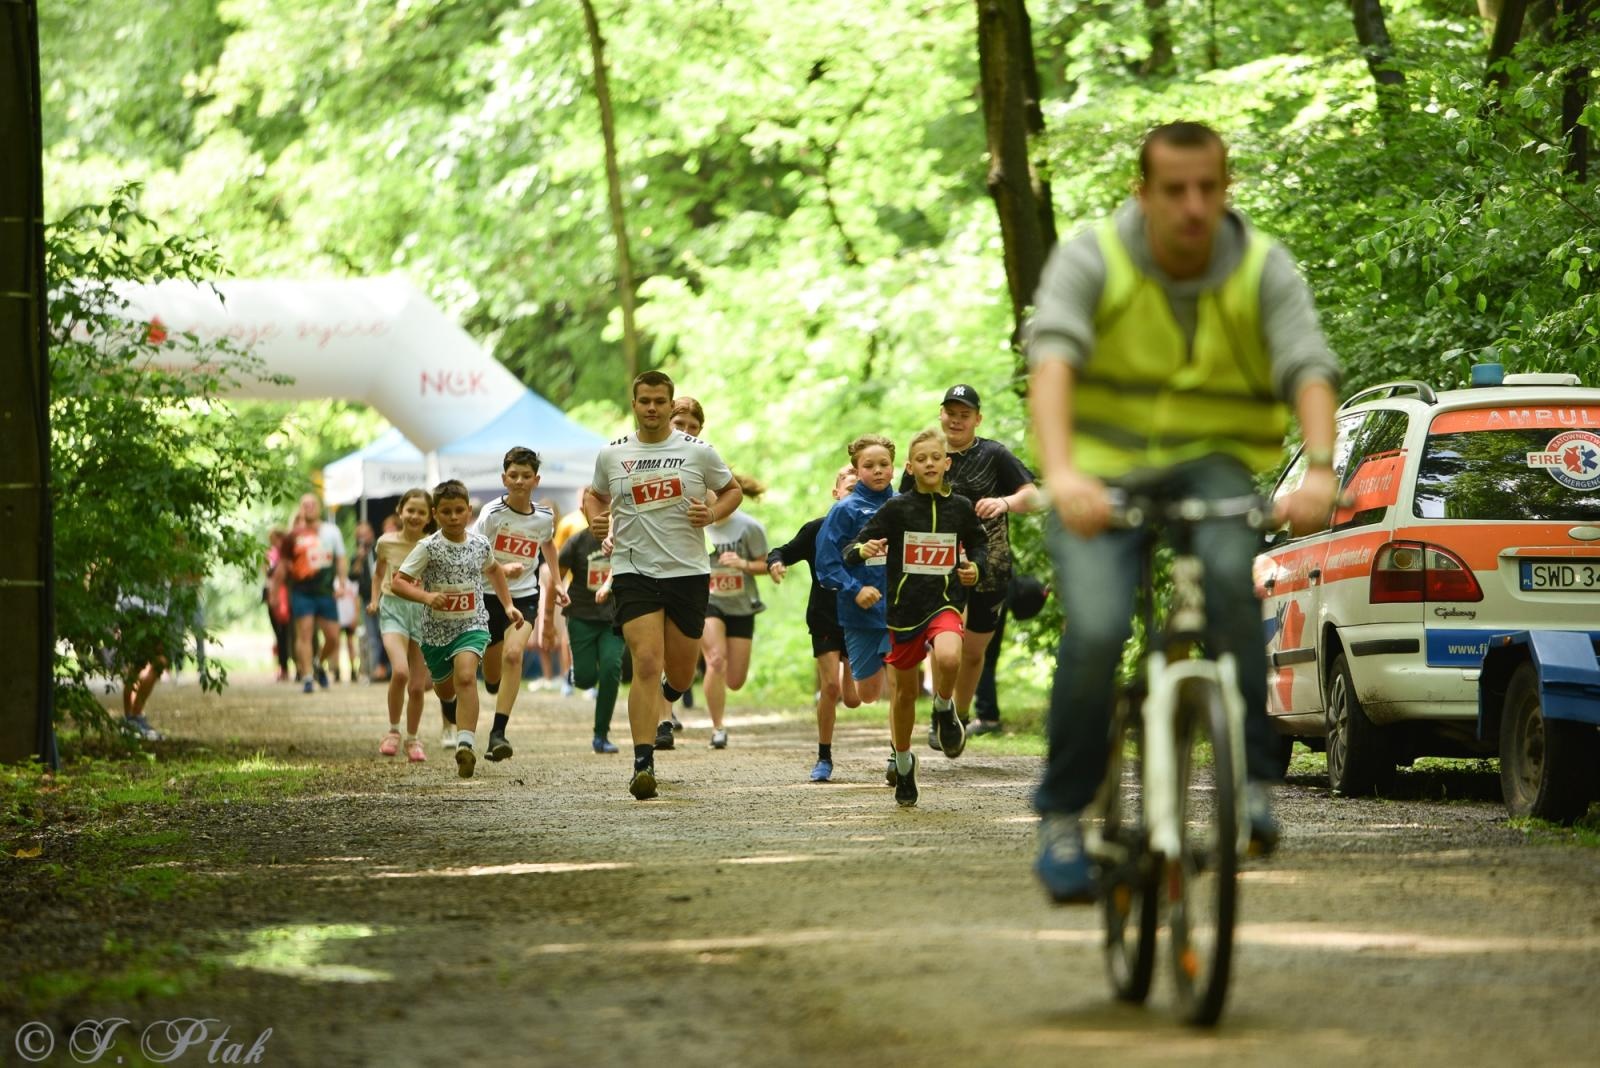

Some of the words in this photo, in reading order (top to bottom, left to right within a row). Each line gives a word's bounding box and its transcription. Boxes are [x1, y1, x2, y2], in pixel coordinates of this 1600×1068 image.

[953, 386, 965, 396] NY
[636, 459, 660, 470] MMA
[663, 458, 685, 470] CITY
[1530, 455, 1563, 465] FIRE
[641, 481, 673, 502] 175
[503, 537, 531, 556] 176
[914, 547, 949, 565] 177
[714, 576, 737, 590] 168
[1534, 566, 1574, 587] SWD
[443, 595, 469, 611] 78
